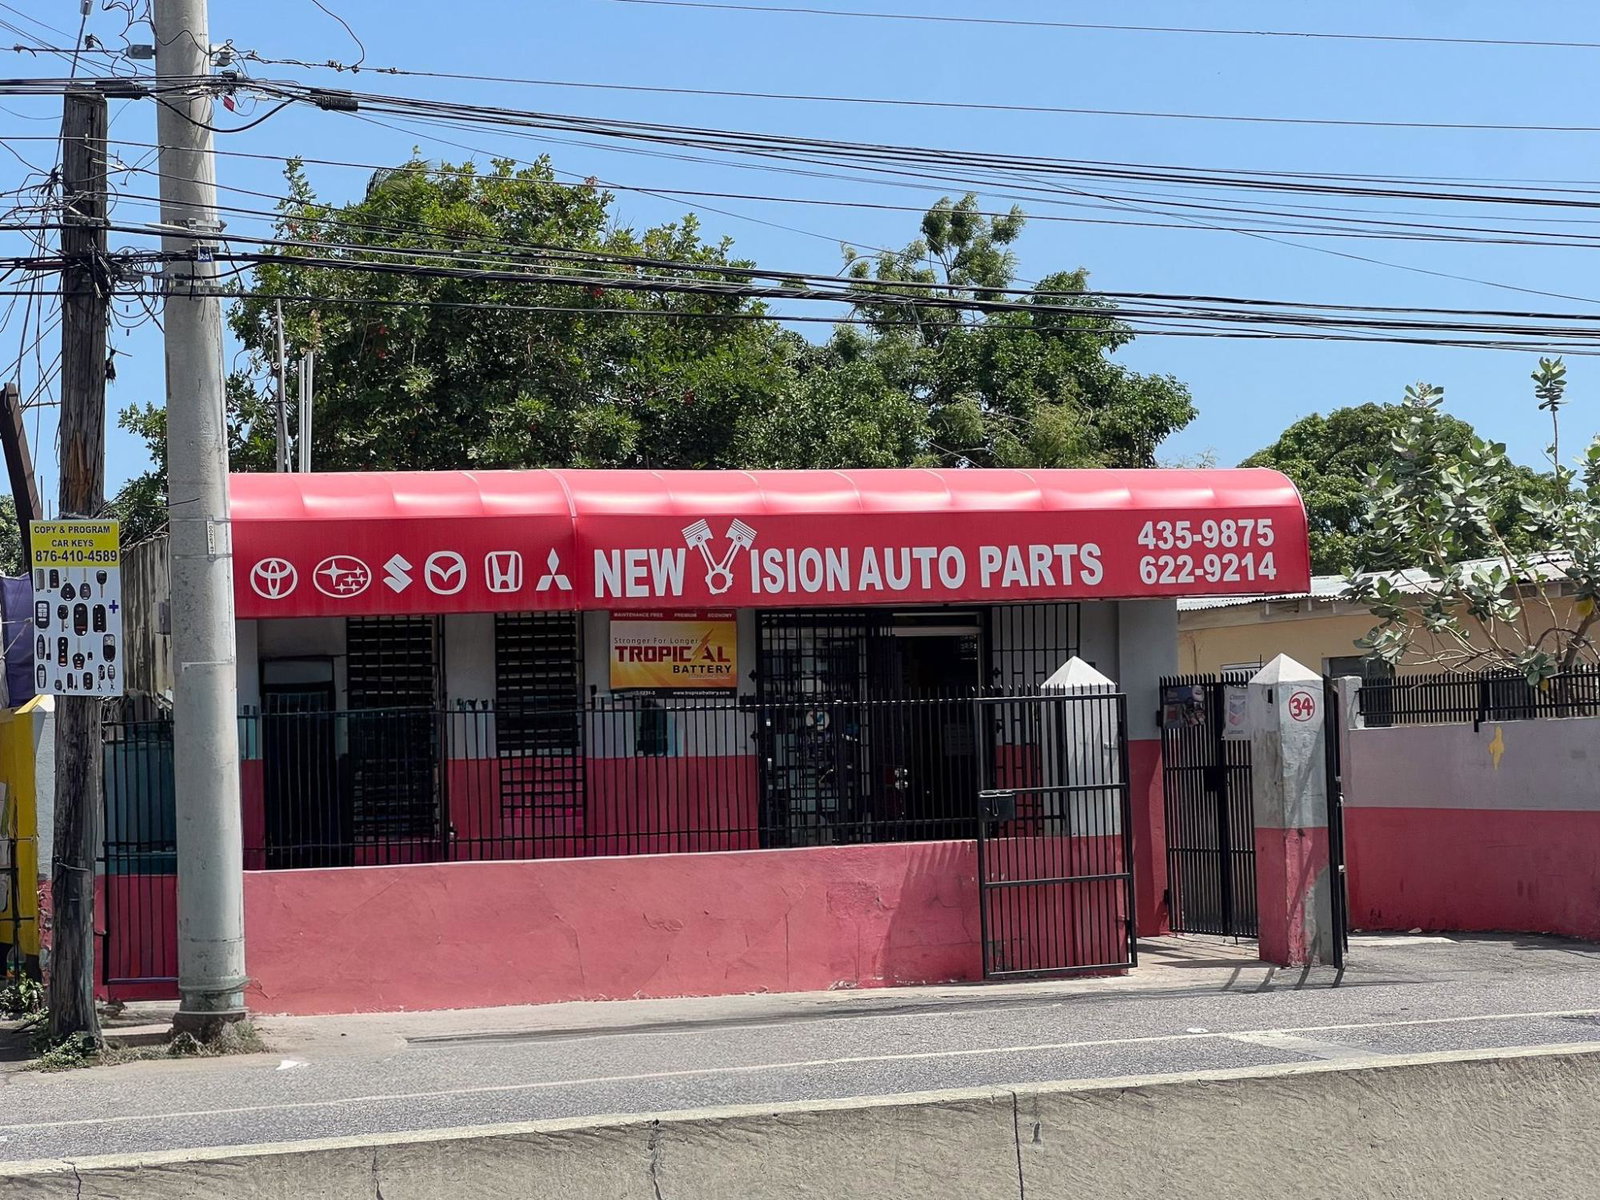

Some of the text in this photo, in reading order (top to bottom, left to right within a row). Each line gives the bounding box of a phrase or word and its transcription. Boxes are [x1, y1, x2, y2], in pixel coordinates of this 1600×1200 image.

[34, 525, 110, 534] COPY & PROGRAM
[1137, 518, 1275, 550] 435-9875
[51, 539, 94, 547] CAR KEYS
[35, 550, 118, 562] 876-410-4589
[593, 547, 686, 598] NEW
[857, 545, 967, 591] AUTO
[978, 542, 1104, 589] PARTS
[1139, 551, 1277, 585] 622-9214
[614, 637, 650, 645] Stronger
[669, 637, 699, 645] Longer
[614, 645, 731, 663] TROPICAL
[672, 664, 732, 674] BATTERY
[1290, 697, 1313, 717] 34
